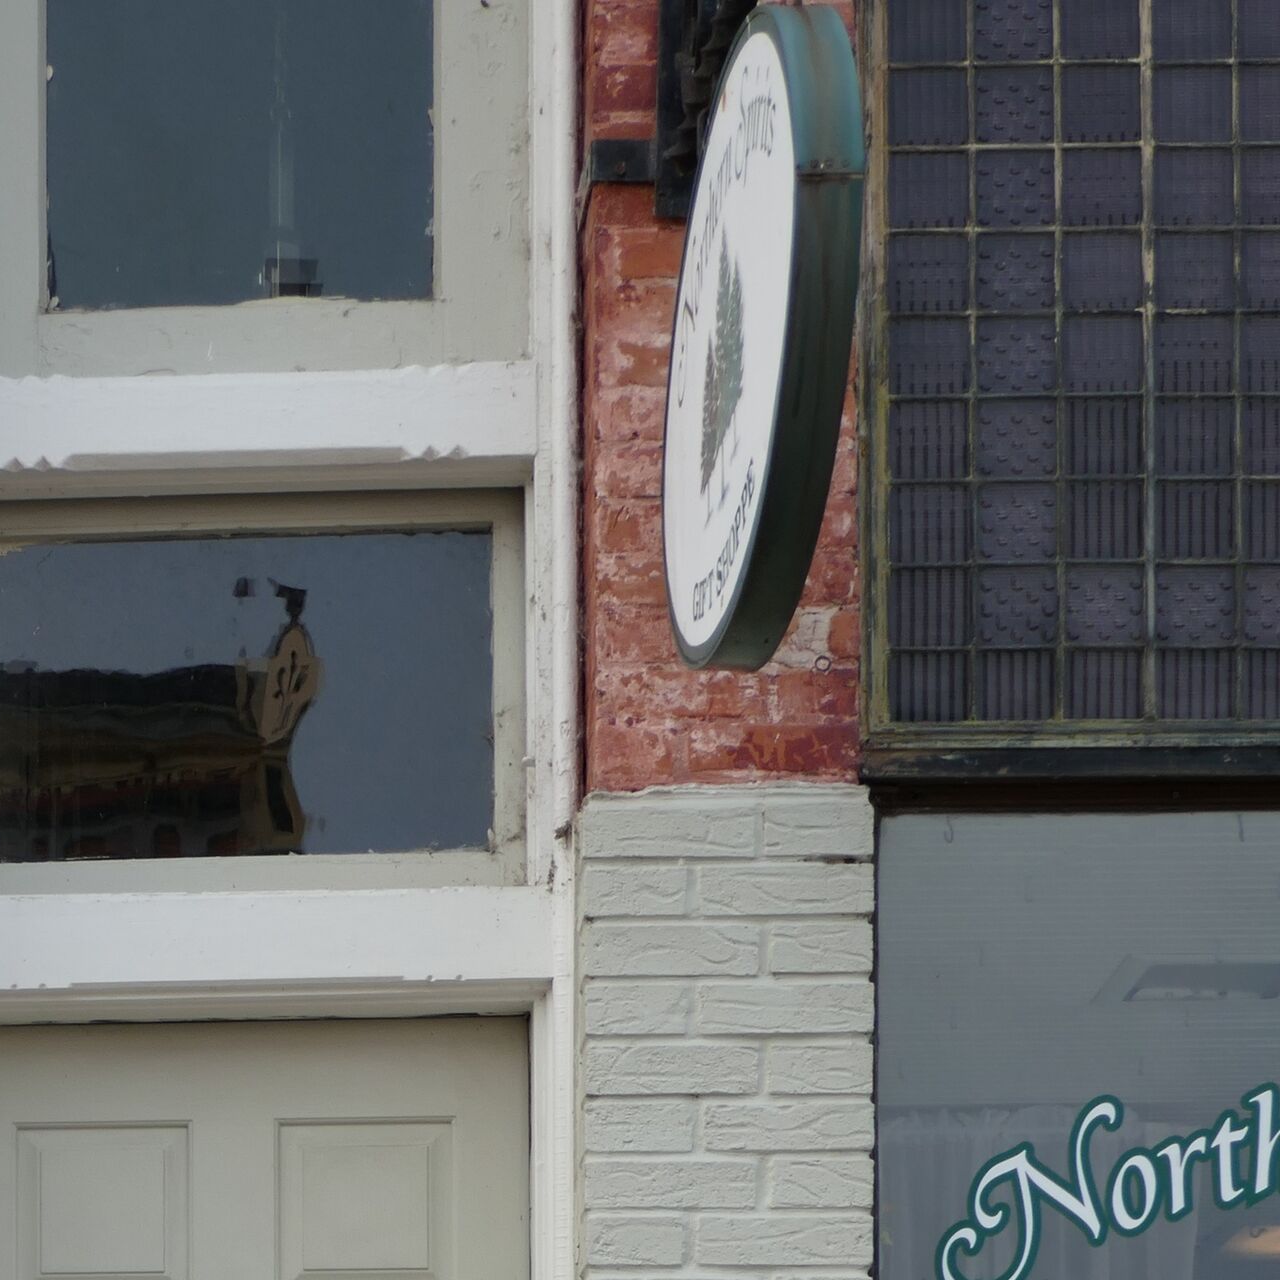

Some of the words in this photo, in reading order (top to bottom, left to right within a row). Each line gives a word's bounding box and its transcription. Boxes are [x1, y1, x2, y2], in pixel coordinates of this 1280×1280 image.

[676, 134, 733, 411] Northern
[734, 64, 778, 188] Spirits
[692, 567, 714, 622] GIFT
